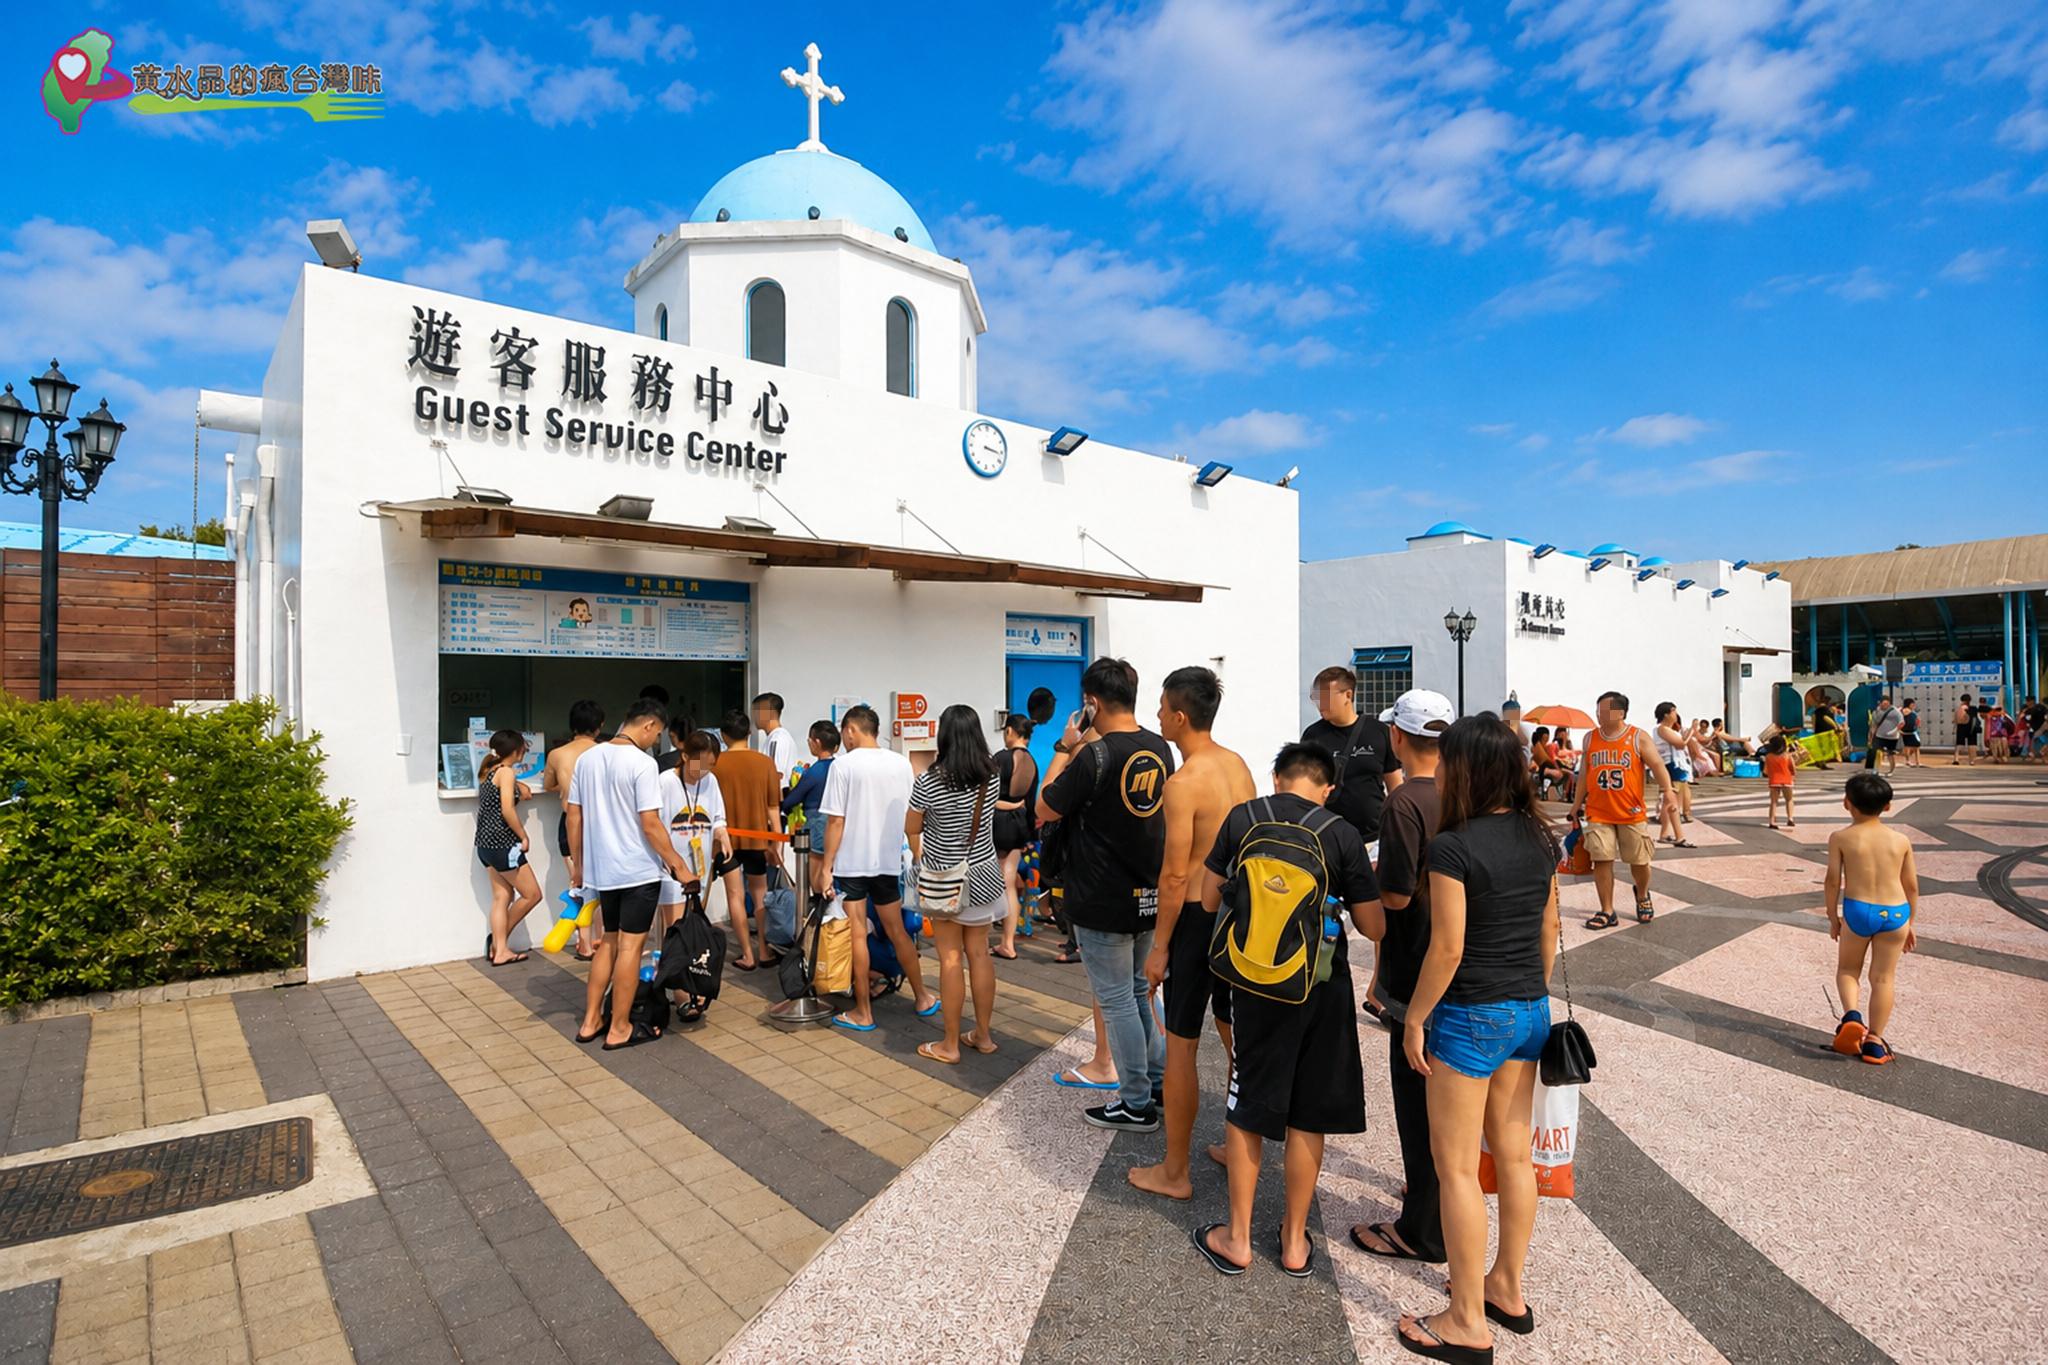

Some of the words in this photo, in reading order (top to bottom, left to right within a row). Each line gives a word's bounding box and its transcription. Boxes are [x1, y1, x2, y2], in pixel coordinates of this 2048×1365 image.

[407, 305, 790, 437] 遊客服務中心
[415, 385, 530, 436] Guest
[545, 407, 675, 457] Service
[687, 431, 787, 474] Center
[1597, 768, 1625, 791] 45
